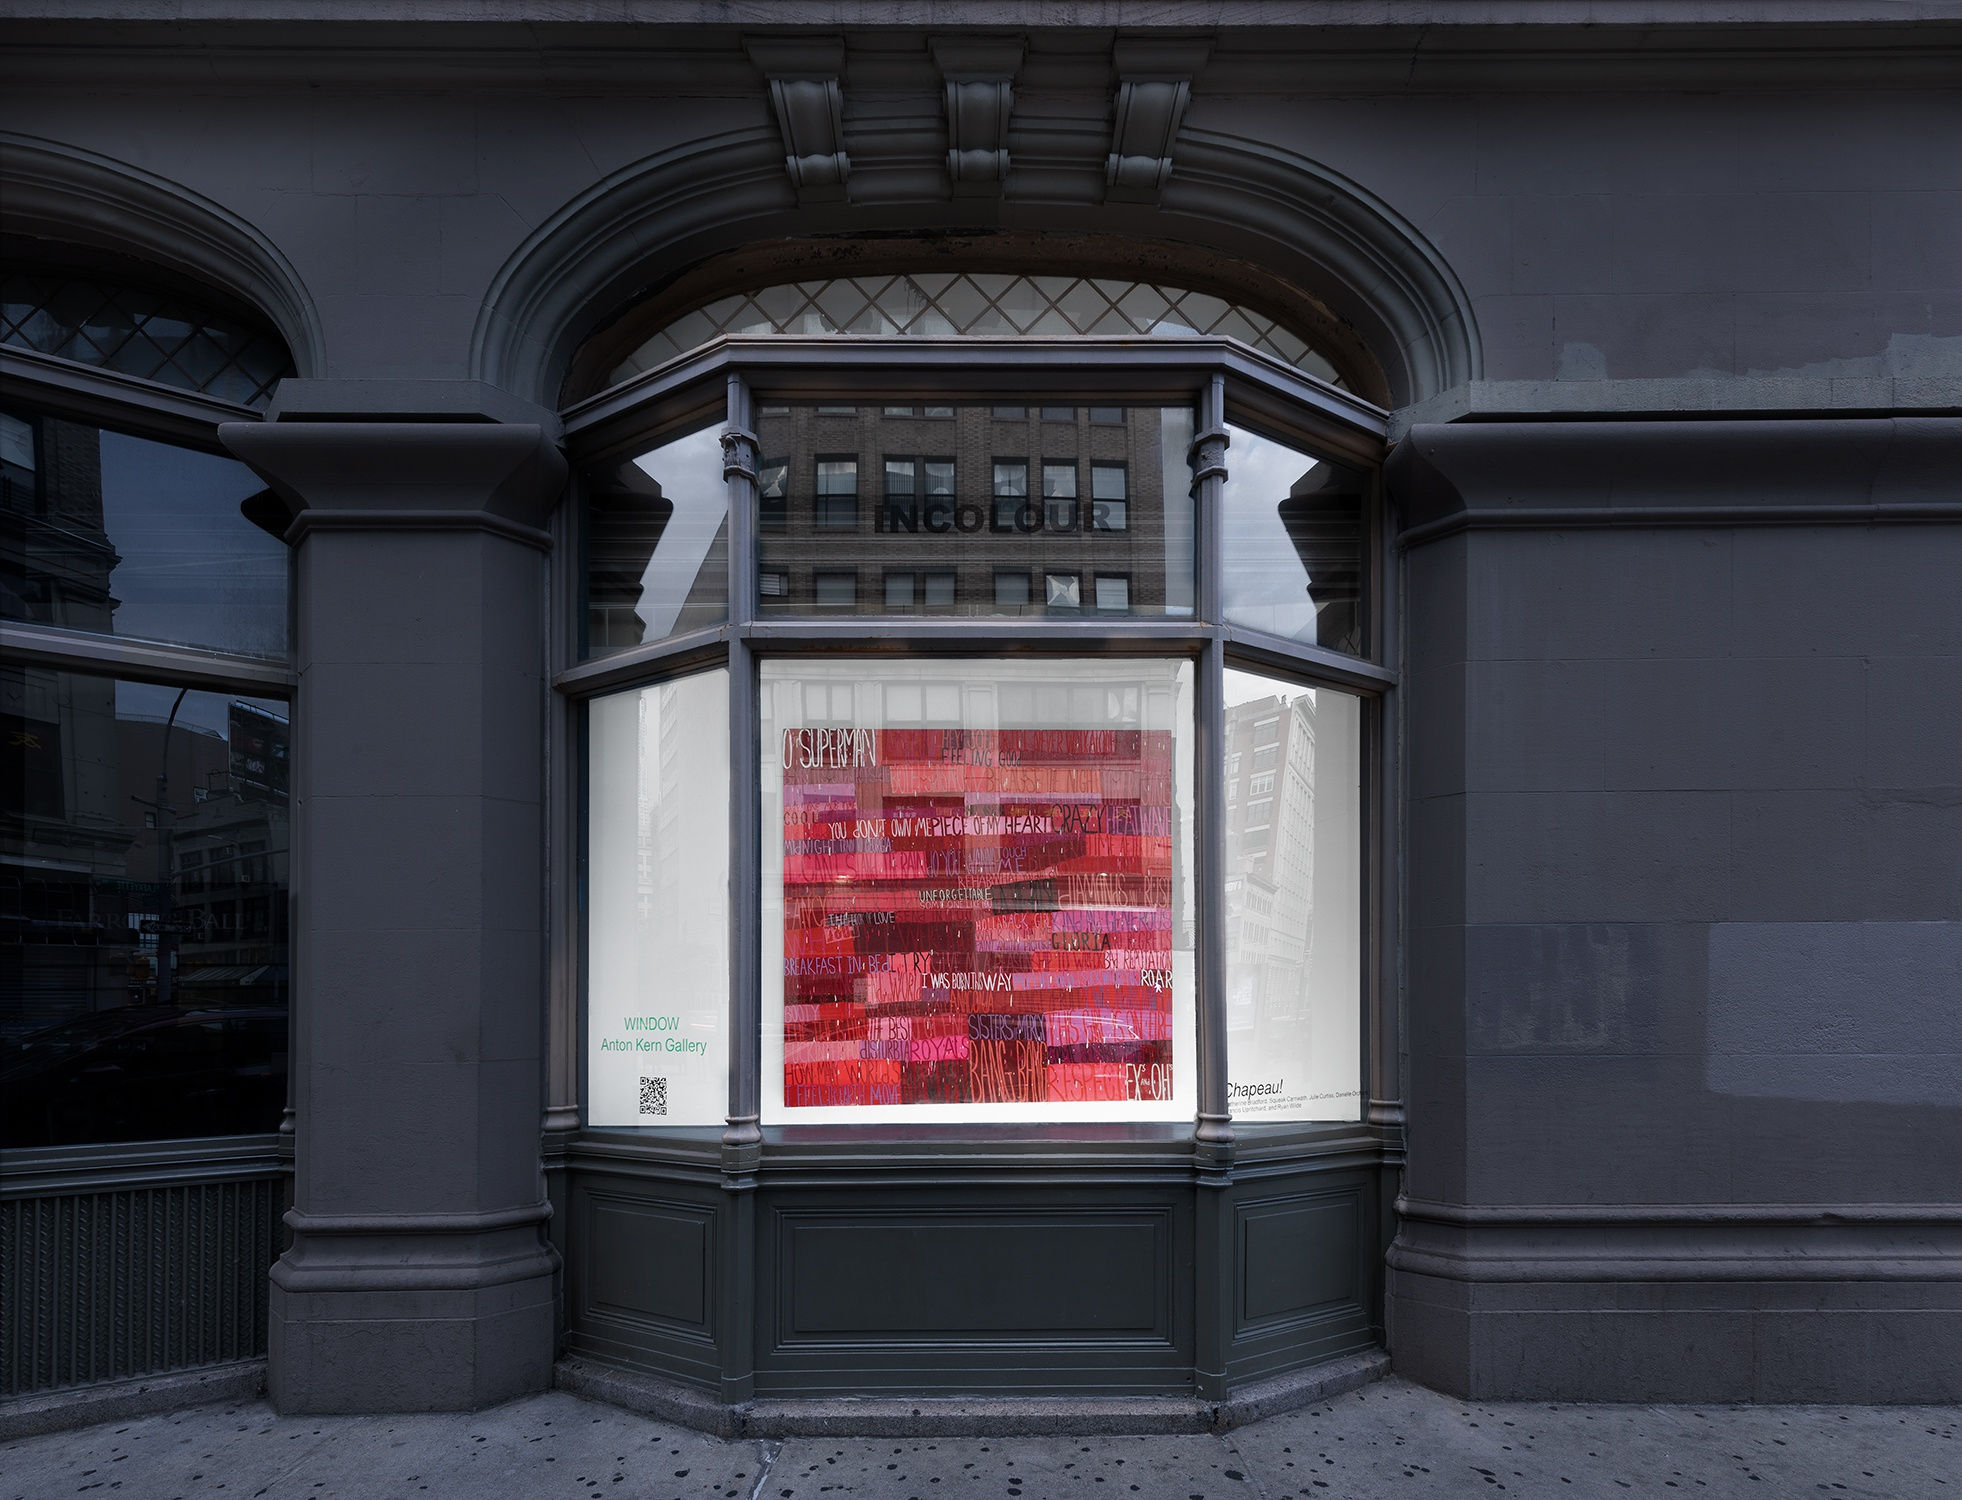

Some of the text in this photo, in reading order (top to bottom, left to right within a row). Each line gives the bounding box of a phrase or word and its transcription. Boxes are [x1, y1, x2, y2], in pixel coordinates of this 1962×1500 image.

[874, 503, 1112, 533] INCOLOUR
[783, 728, 876, 769] O SUPERMAN
[941, 748, 992, 767] FEELING
[784, 811, 818, 825] COOL
[932, 816, 967, 837] PIECE
[987, 816, 1000, 836] MY
[1004, 815, 1050, 835] HEART
[1051, 804, 1105, 834] CRAZY
[829, 822, 847, 839] YOU
[891, 818, 911, 838] OWN
[915, 818, 932, 837] ME
[996, 847, 1027, 860] TOUCH
[998, 858, 1027, 873] ME
[919, 888, 993, 902] UNFORGETTABLE
[873, 911, 895, 924] LOVE
[1052, 932, 1111, 951] GLORIA
[784, 956, 842, 976] BREAKFAST
[848, 956, 862, 974] IN
[921, 973, 928, 989] I
[931, 972, 950, 989] WAS
[982, 972, 1012, 992] WAY
[1141, 969, 1173, 988] ROAR
[624, 1016, 680, 1031] WINDOW
[888, 1017, 911, 1040] BEST
[968, 1014, 1014, 1041] SISTERS
[601, 1038, 707, 1056] Anton Kern Gallery
[910, 1036, 969, 1062] ROYALS
[970, 1040, 1015, 1103] BANG
[1016, 1040, 1048, 1102] BANG
[1048, 1063, 1124, 1102] RESPECT
[1227, 1079, 1284, 1100] Chapeau!
[797, 1084, 824, 1107] FEEL
[869, 1084, 900, 1105] MOVE
